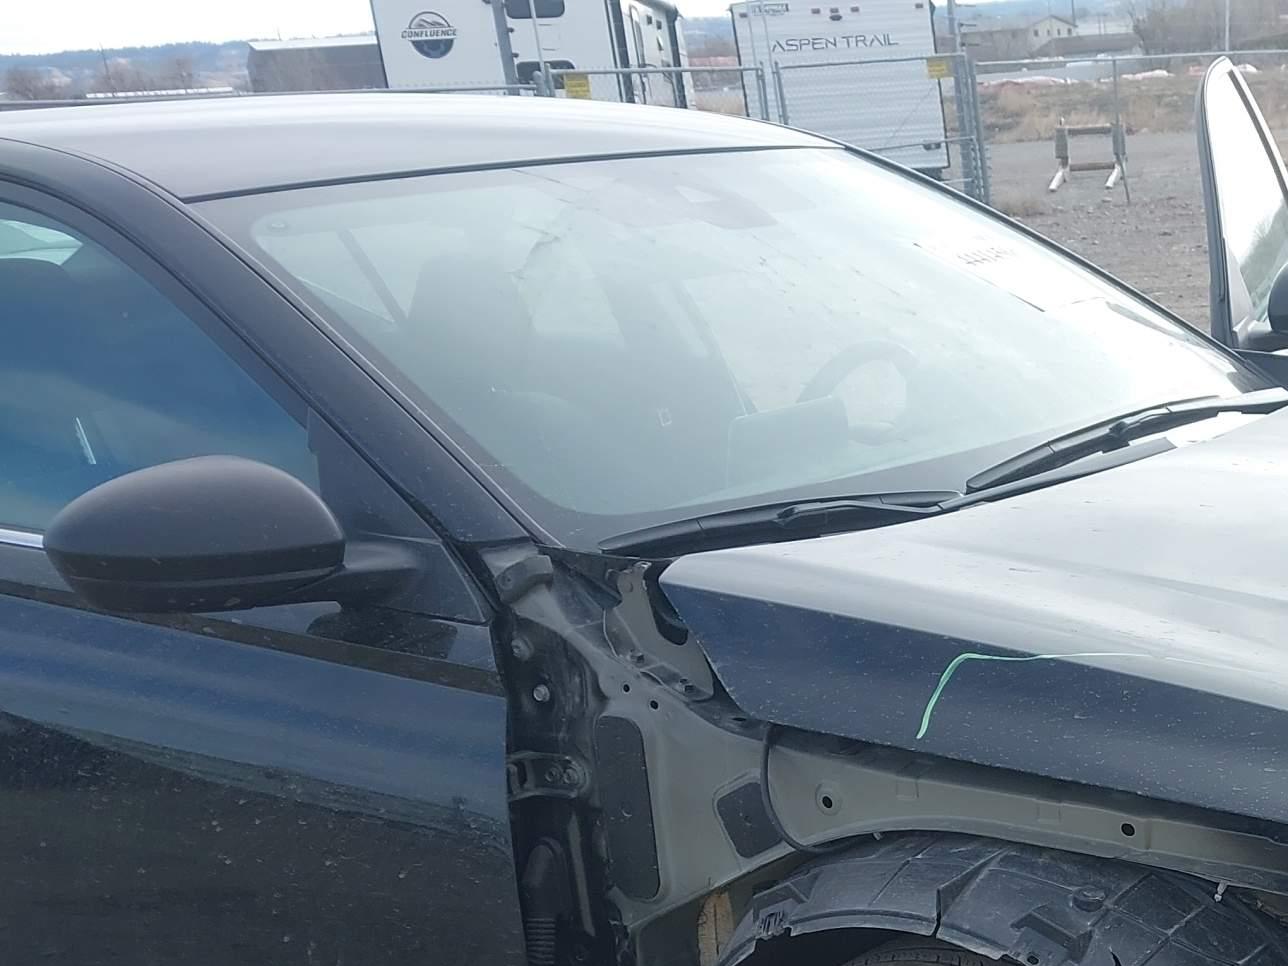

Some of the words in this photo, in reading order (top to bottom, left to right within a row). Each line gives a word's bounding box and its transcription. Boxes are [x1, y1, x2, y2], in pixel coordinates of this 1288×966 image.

[401, 29, 457, 39] CONFLUENCE
[772, 37, 837, 52] ASPEN
[841, 33, 899, 48] TRAIL
